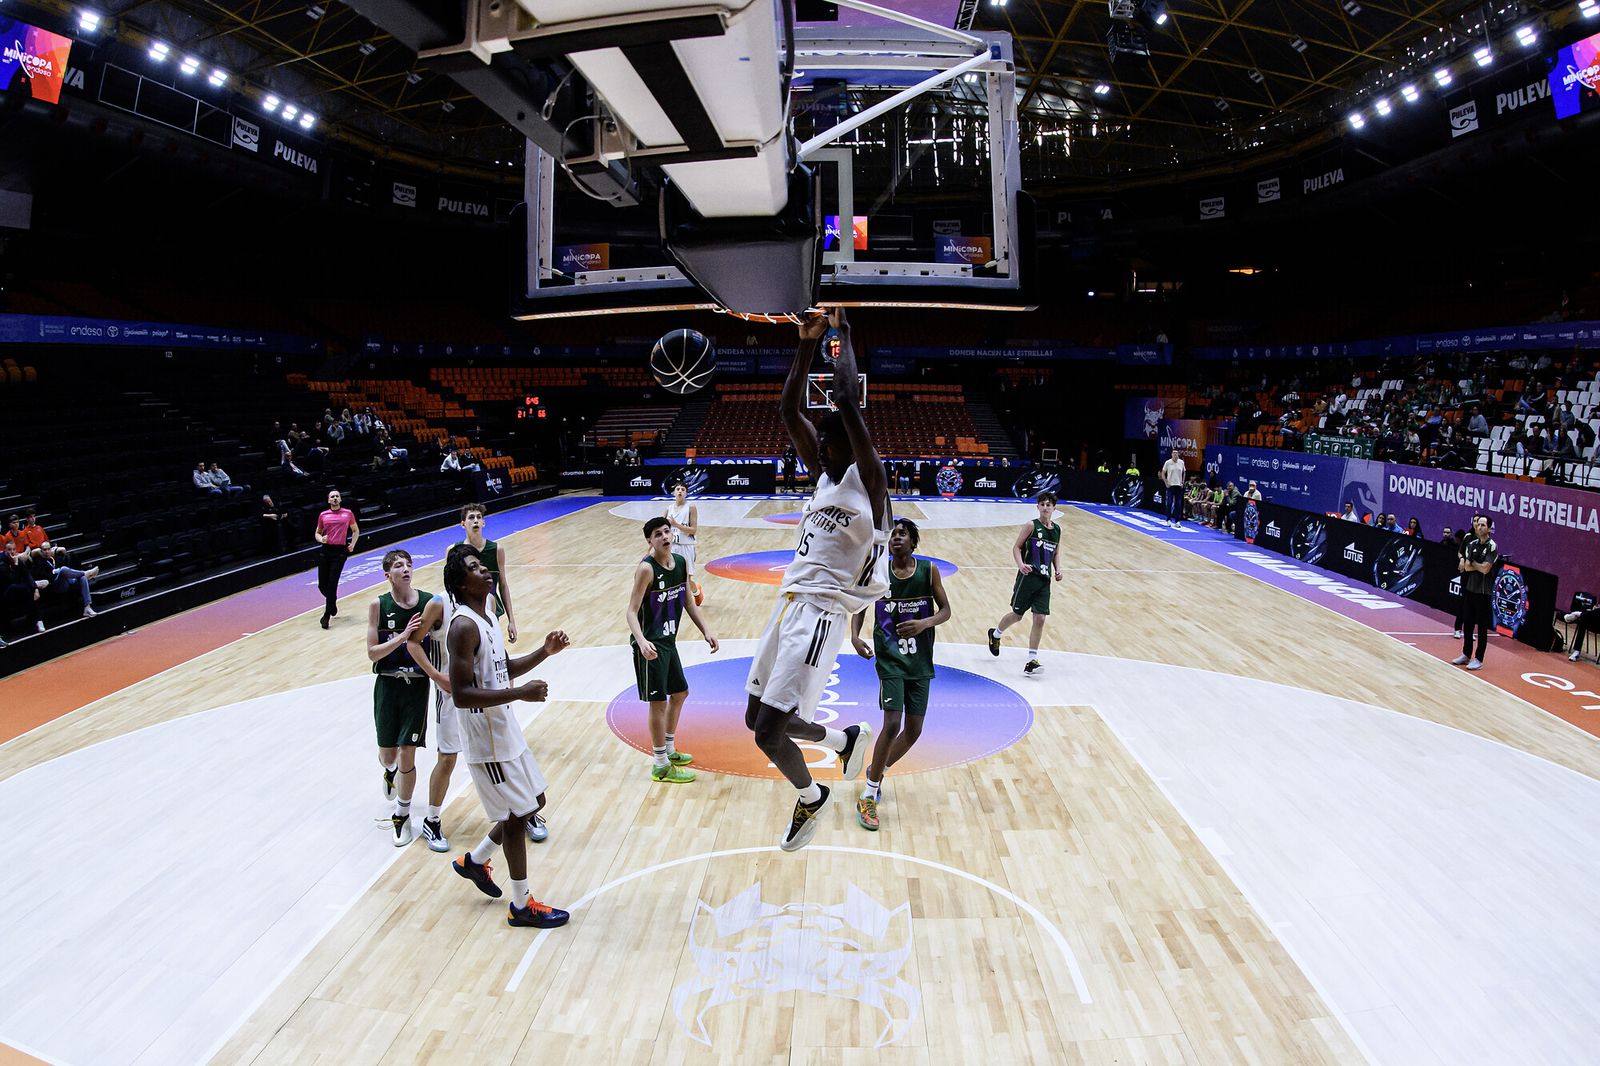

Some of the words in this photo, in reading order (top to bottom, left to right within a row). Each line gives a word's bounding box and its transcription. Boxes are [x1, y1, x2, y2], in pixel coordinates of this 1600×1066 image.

[1451, 105, 1475, 121] PULEVA
[236, 119, 258, 137] PULEVA
[274, 139, 318, 174] PULEVA
[1303, 168, 1345, 195] PULEVA
[438, 197, 489, 217] PULEVA
[71, 325, 103, 336] endesa
[1251, 458, 1270, 468] endesa
[630, 479, 652, 487] LOTUS
[1389, 474, 1433, 499] DONDE
[1436, 482, 1485, 509] NACEN
[1488, 490, 1515, 515] LAS
[1519, 495, 1600, 534] ESTRELLA
[1266, 526, 1281, 538] LOTUS
[1343, 550, 1364, 564] LOTUS
[1228, 551, 1406, 610] VALENCIA
[662, 620, 676, 636] 34
[898, 637, 917, 655] 33
